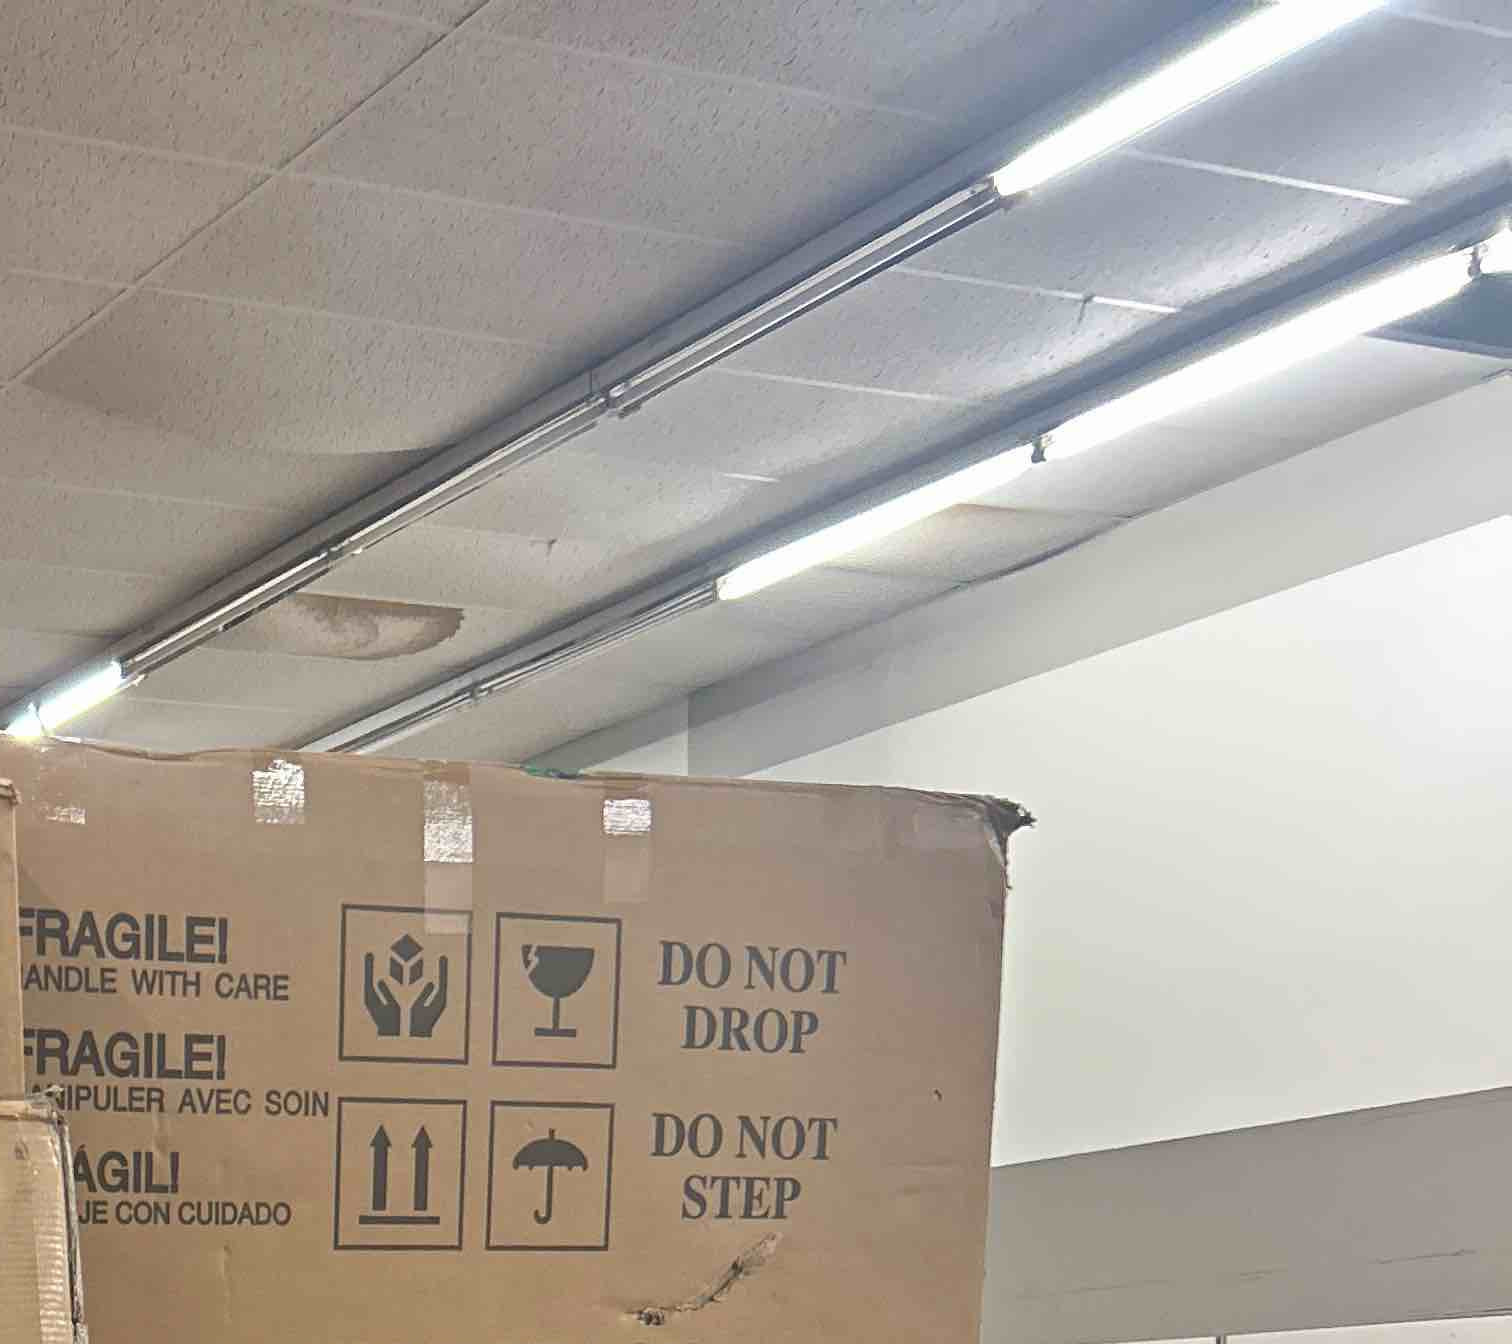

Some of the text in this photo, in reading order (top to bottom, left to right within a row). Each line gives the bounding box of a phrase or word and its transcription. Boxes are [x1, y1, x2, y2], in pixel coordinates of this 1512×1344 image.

[22, 964, 289, 1000] ANDLE WITH CARE
[658, 940, 848, 995] DO NOT
[681, 1006, 820, 1054] DROP
[33, 1085, 329, 1116] NIPULER AVEC SOIN
[651, 1112, 840, 1162] DO NOT
[73, 1144, 180, 1194] ÁGIL!
[116, 1201, 169, 1225] CON
[179, 1202, 291, 1226] CUIDADO
[680, 1175, 802, 1220] STEP
